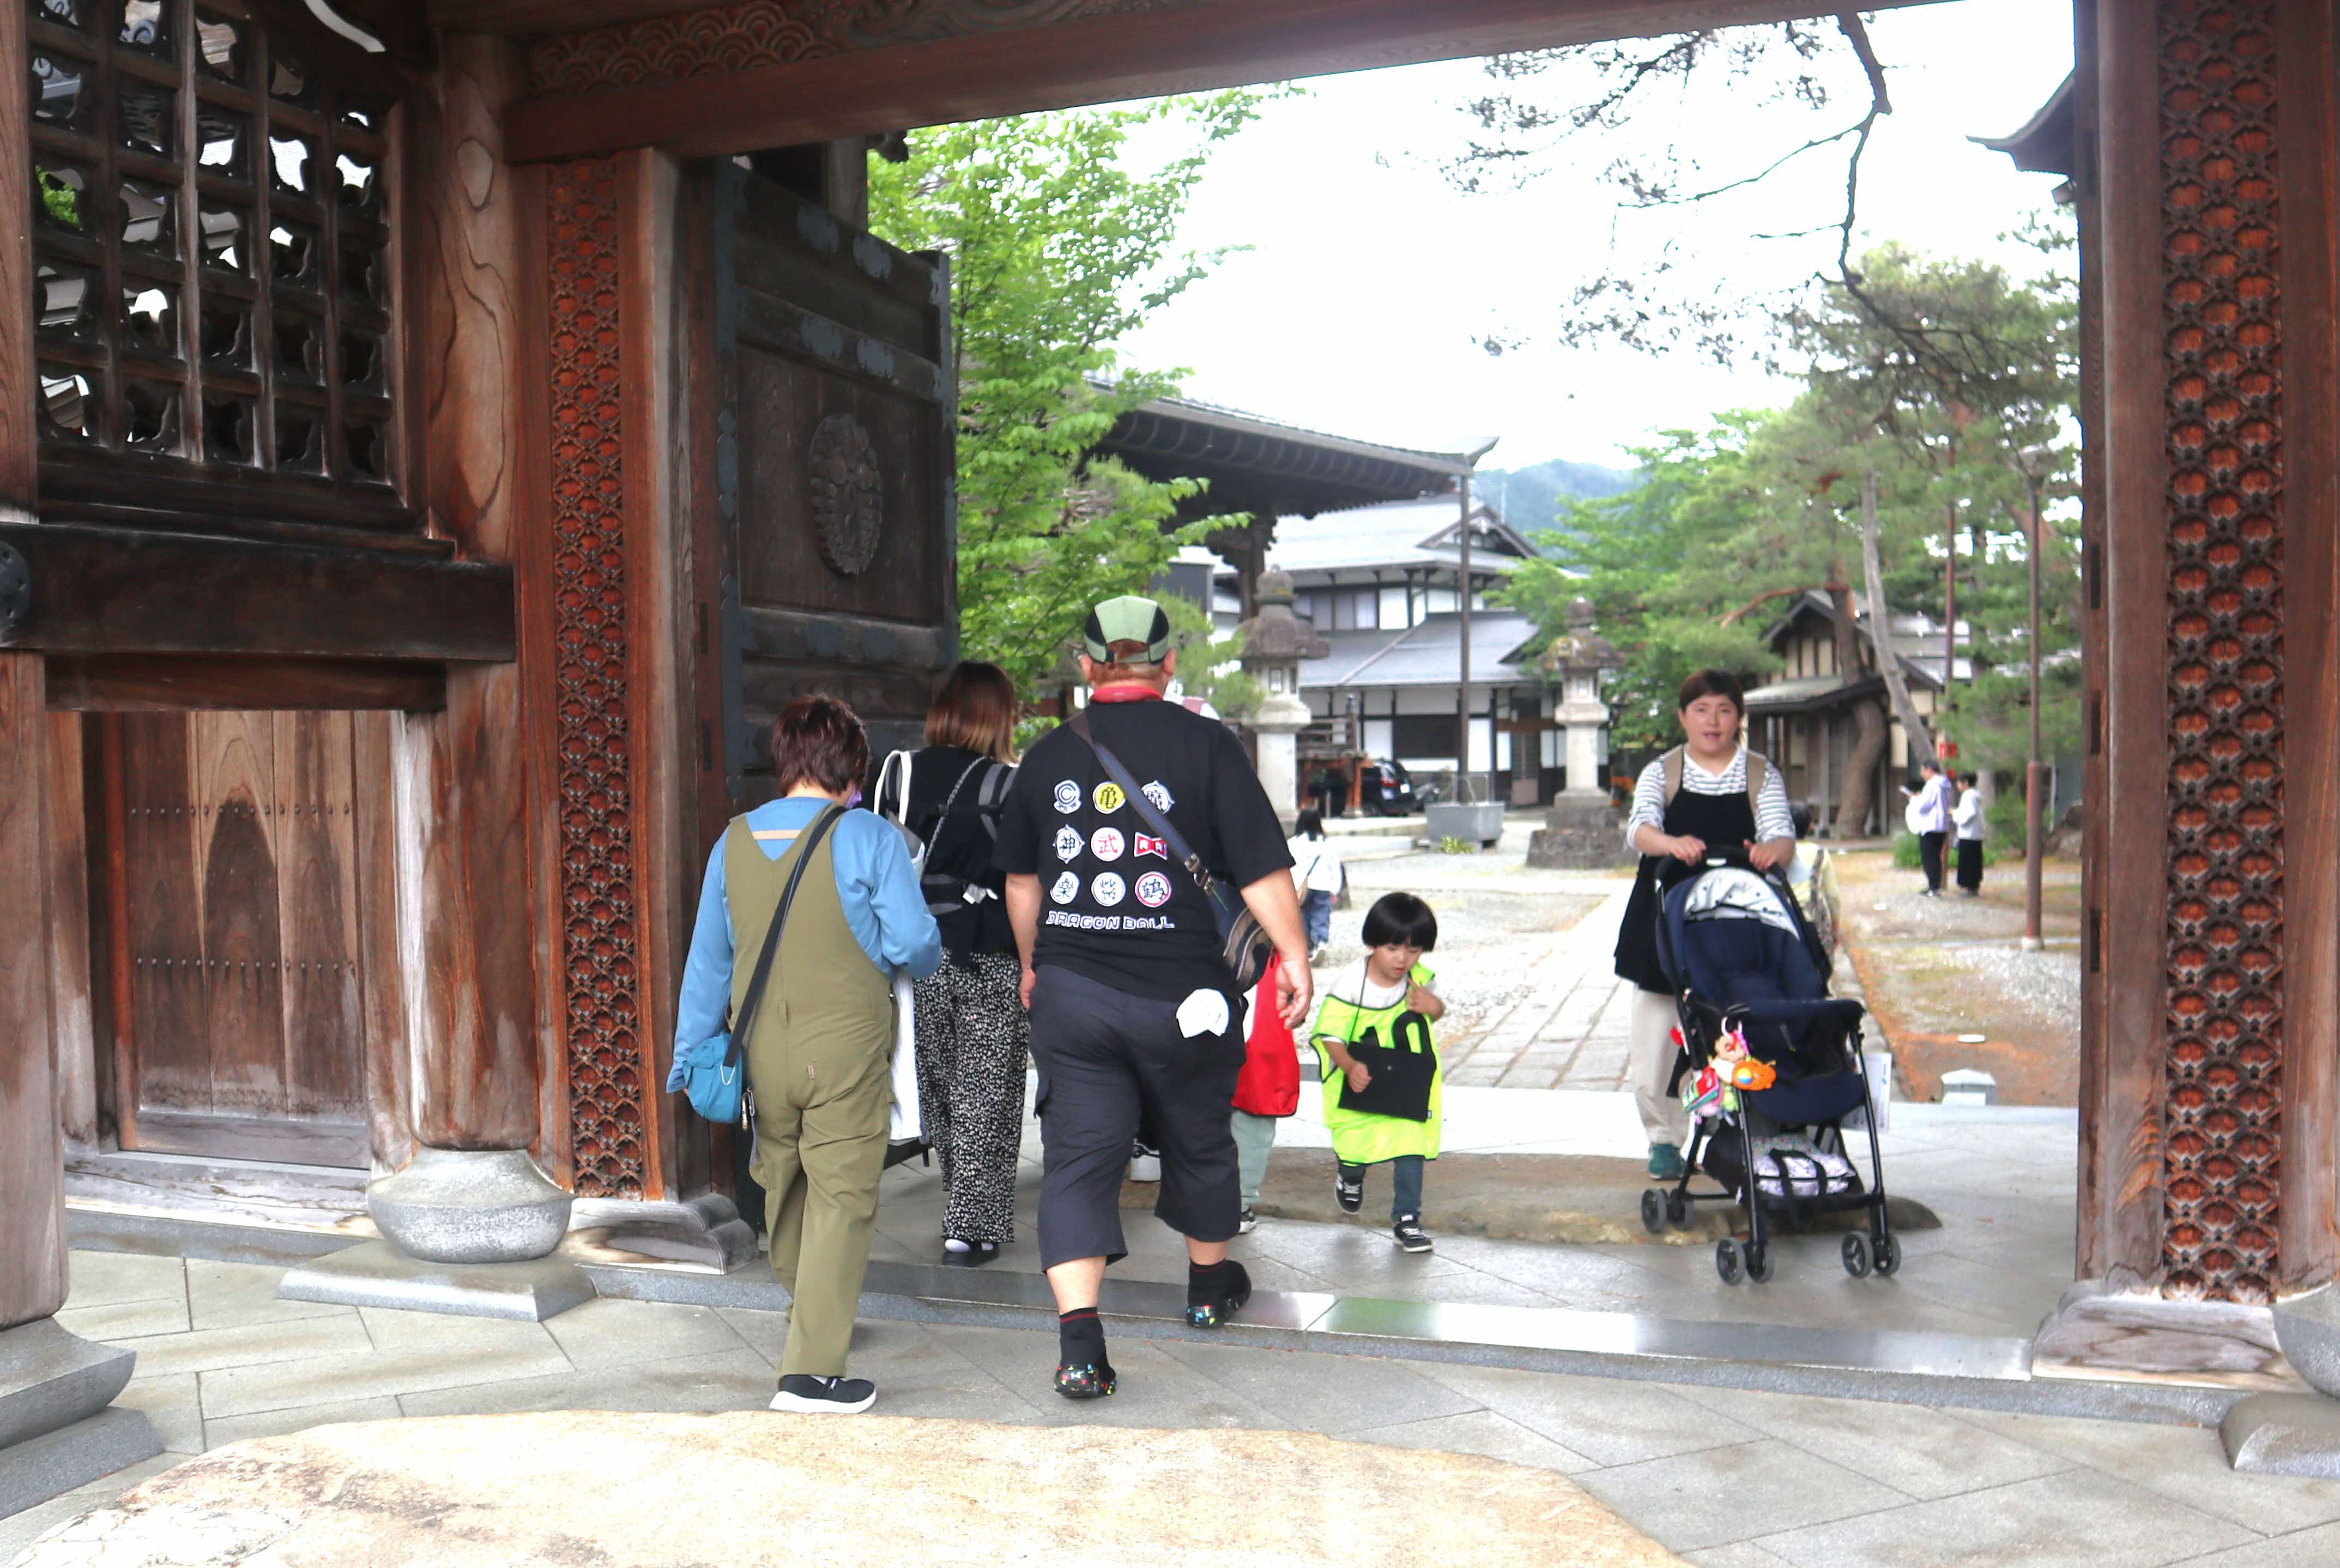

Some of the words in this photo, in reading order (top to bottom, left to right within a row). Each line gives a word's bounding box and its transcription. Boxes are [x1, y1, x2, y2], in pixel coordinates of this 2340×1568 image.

[1100, 786, 1117, 809] 亀
[1059, 834, 1075, 854] 神
[1098, 834, 1118, 854] 武
[1045, 910, 1121, 930] DRAGON
[1123, 916, 1176, 930] BALL
